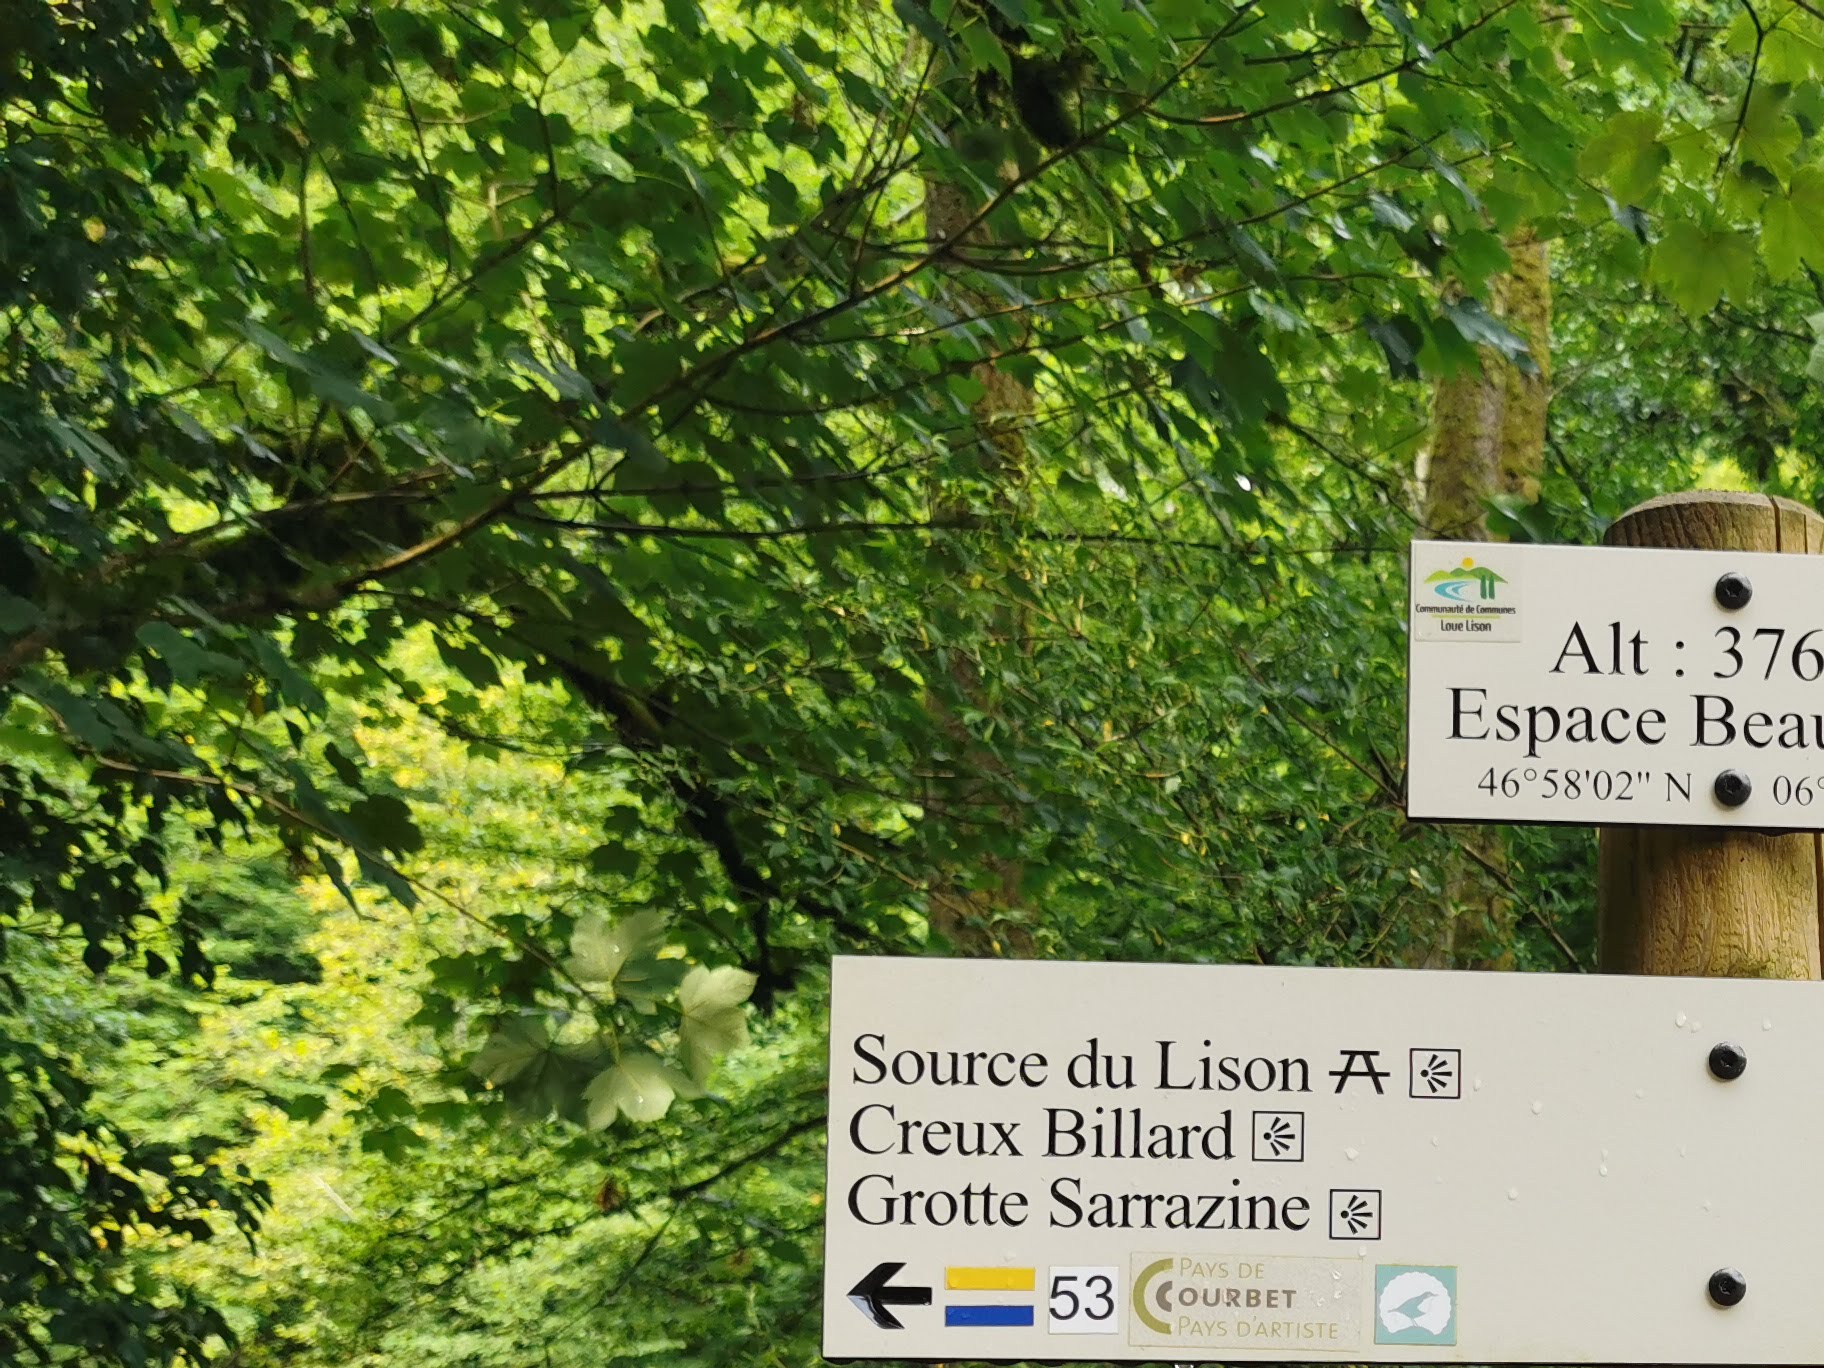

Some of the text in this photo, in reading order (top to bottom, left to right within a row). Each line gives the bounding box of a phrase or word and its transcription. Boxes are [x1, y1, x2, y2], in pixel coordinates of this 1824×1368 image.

[1415, 603, 1516, 614] Communauté de Communes
[1441, 619, 1491, 631] Loue Lison
[1549, 621, 1648, 675] Alt
[1714, 626, 1824, 681] 376
[1446, 688, 1666, 758] Espace
[1665, 773, 1691, 801] N
[853, 1034, 1312, 1092] Source du Lison
[850, 1104, 1236, 1160] Creux Billard
[848, 1174, 1310, 1231] Grotte Sarrazine
[1180, 1258, 1264, 1279] PAYS DE
[1049, 1276, 1114, 1320] 53
[1177, 1316, 1338, 1339] PAYS D'ARTISTE
